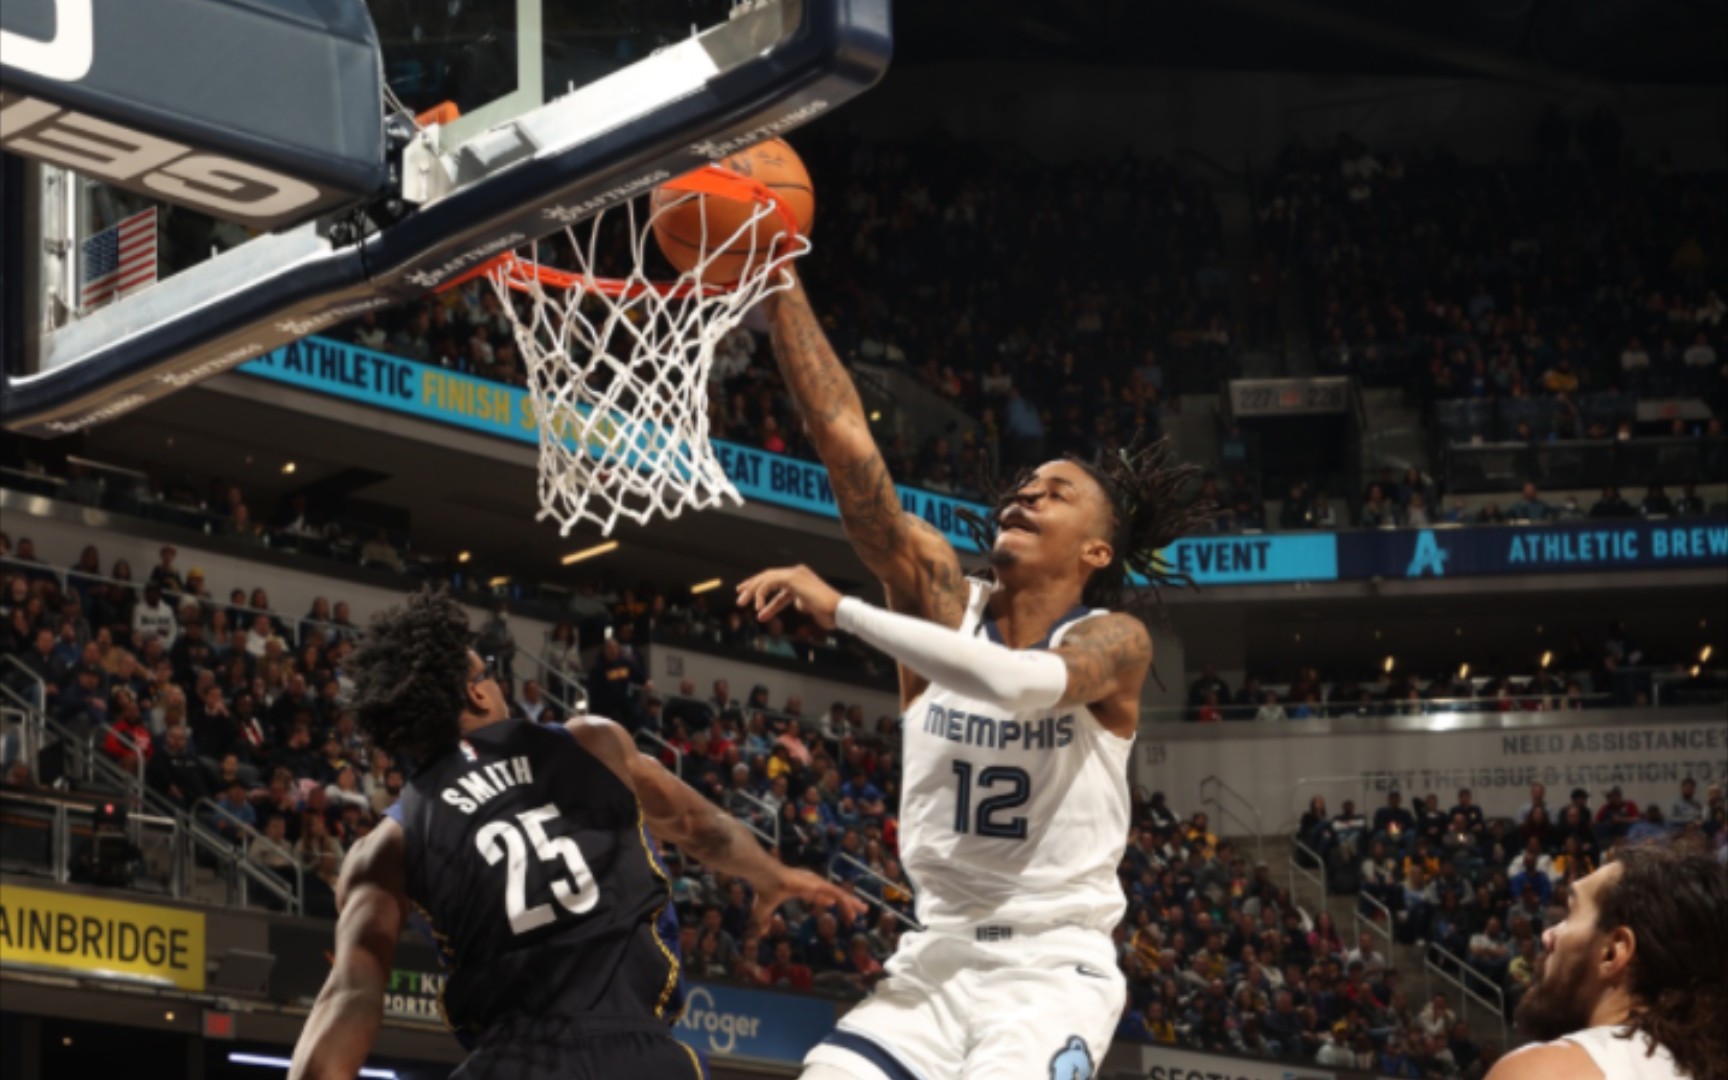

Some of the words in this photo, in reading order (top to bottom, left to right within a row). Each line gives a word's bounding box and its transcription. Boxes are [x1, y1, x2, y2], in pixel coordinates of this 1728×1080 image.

[284, 338, 414, 399] ATHLETIC
[422, 371, 511, 425] FINISH
[1176, 540, 1271, 573] EVENT
[1508, 530, 1639, 563] ATHLETIC
[923, 703, 1075, 750] MEMPHIS
[1502, 735, 1563, 755] NEED
[441, 756, 534, 815] SMITH
[952, 759, 1031, 839] 12
[1361, 768, 1415, 791] TEXT
[1421, 767, 1466, 790] THE
[1471, 765, 1538, 788] ISSUE
[1565, 760, 1677, 786] LOCATION
[1681, 760, 1712, 781] TO
[475, 803, 600, 935] 25
